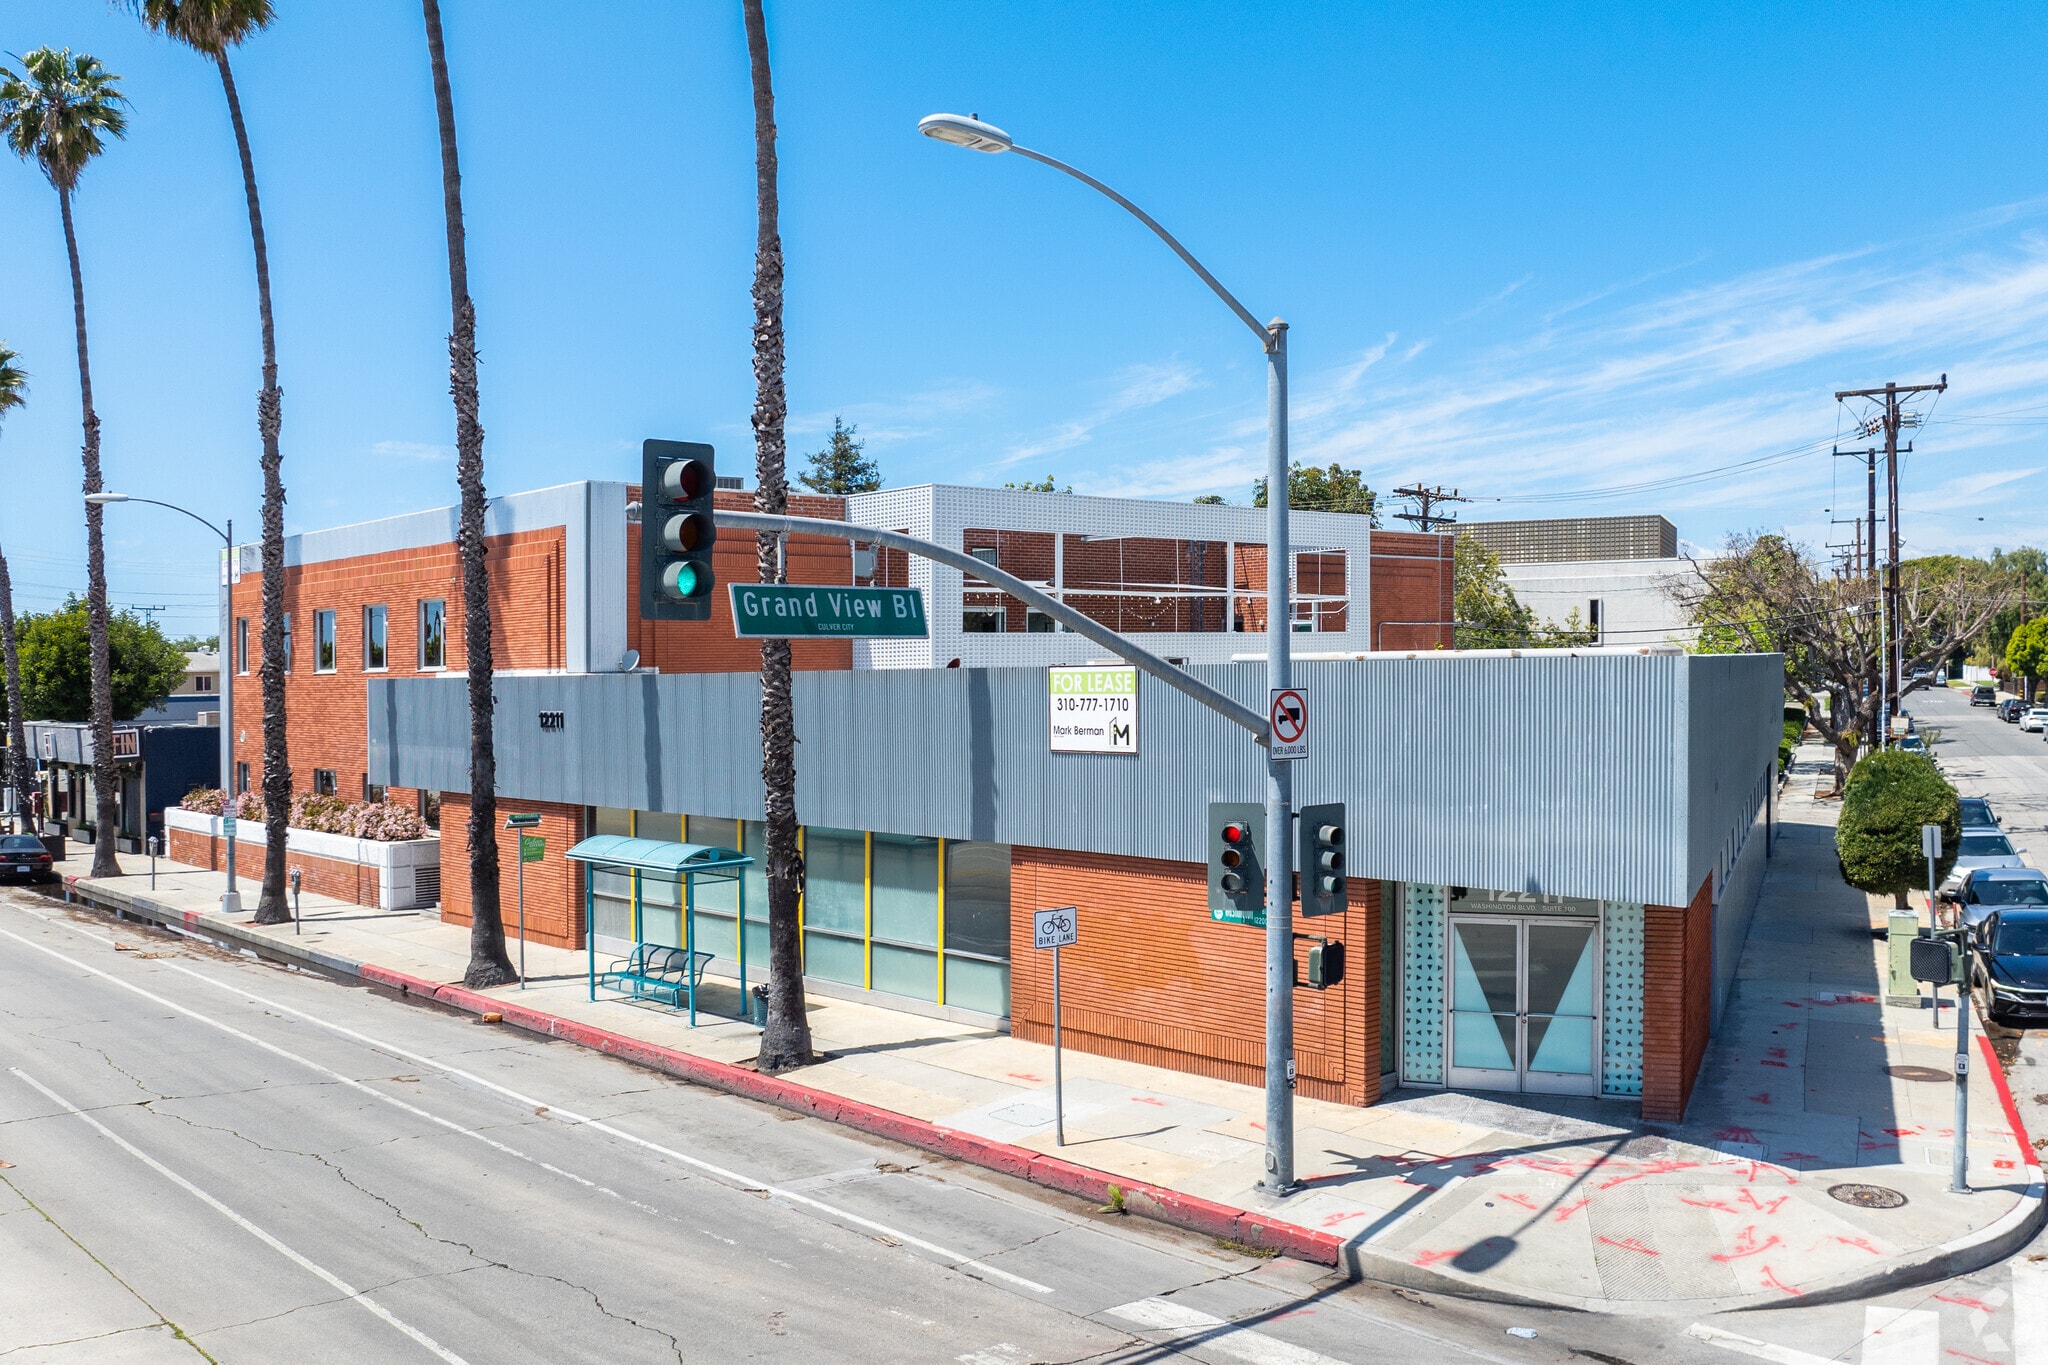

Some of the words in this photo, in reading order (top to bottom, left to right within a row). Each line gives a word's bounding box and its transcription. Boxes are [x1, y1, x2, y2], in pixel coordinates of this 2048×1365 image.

[742, 590, 819, 618] Grand
[825, 592, 882, 618] View
[892, 594, 917, 618] Bl
[817, 623, 841, 631] CULVER
[842, 623, 855, 631] CITY
[1054, 674, 1082, 692] FOR
[1088, 674, 1131, 692] LEASE
[1057, 698, 1128, 711] 310-777-1710
[539, 712, 564, 728] 12211
[1053, 725, 1072, 735] Mark
[1074, 725, 1104, 735] Berman
[1273, 747, 1283, 755] OVER
[1471, 903, 1516, 911] WASHINGTON
[1039, 937, 1055, 945] BIKE
[1059, 932, 1074, 942] LANE
